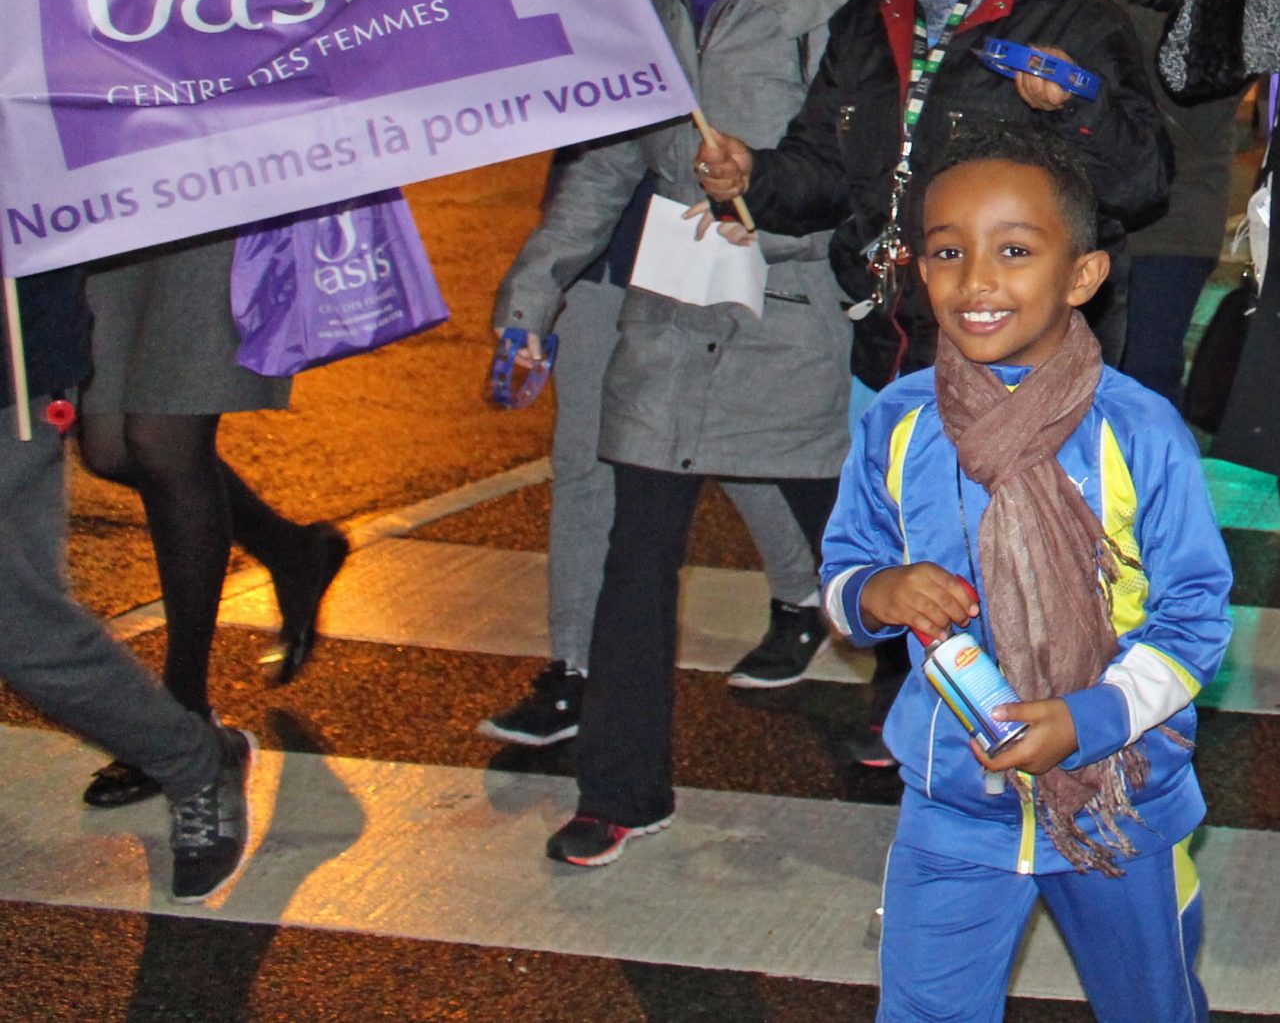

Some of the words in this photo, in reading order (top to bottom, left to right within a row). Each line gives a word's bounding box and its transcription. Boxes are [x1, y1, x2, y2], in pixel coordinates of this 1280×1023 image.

[6, 186, 139, 245] Nous
[154, 134, 357, 204] sommes
[366, 117, 410, 157] là
[423, 95, 532, 156] pour
[544, 62, 669, 114] vous!
